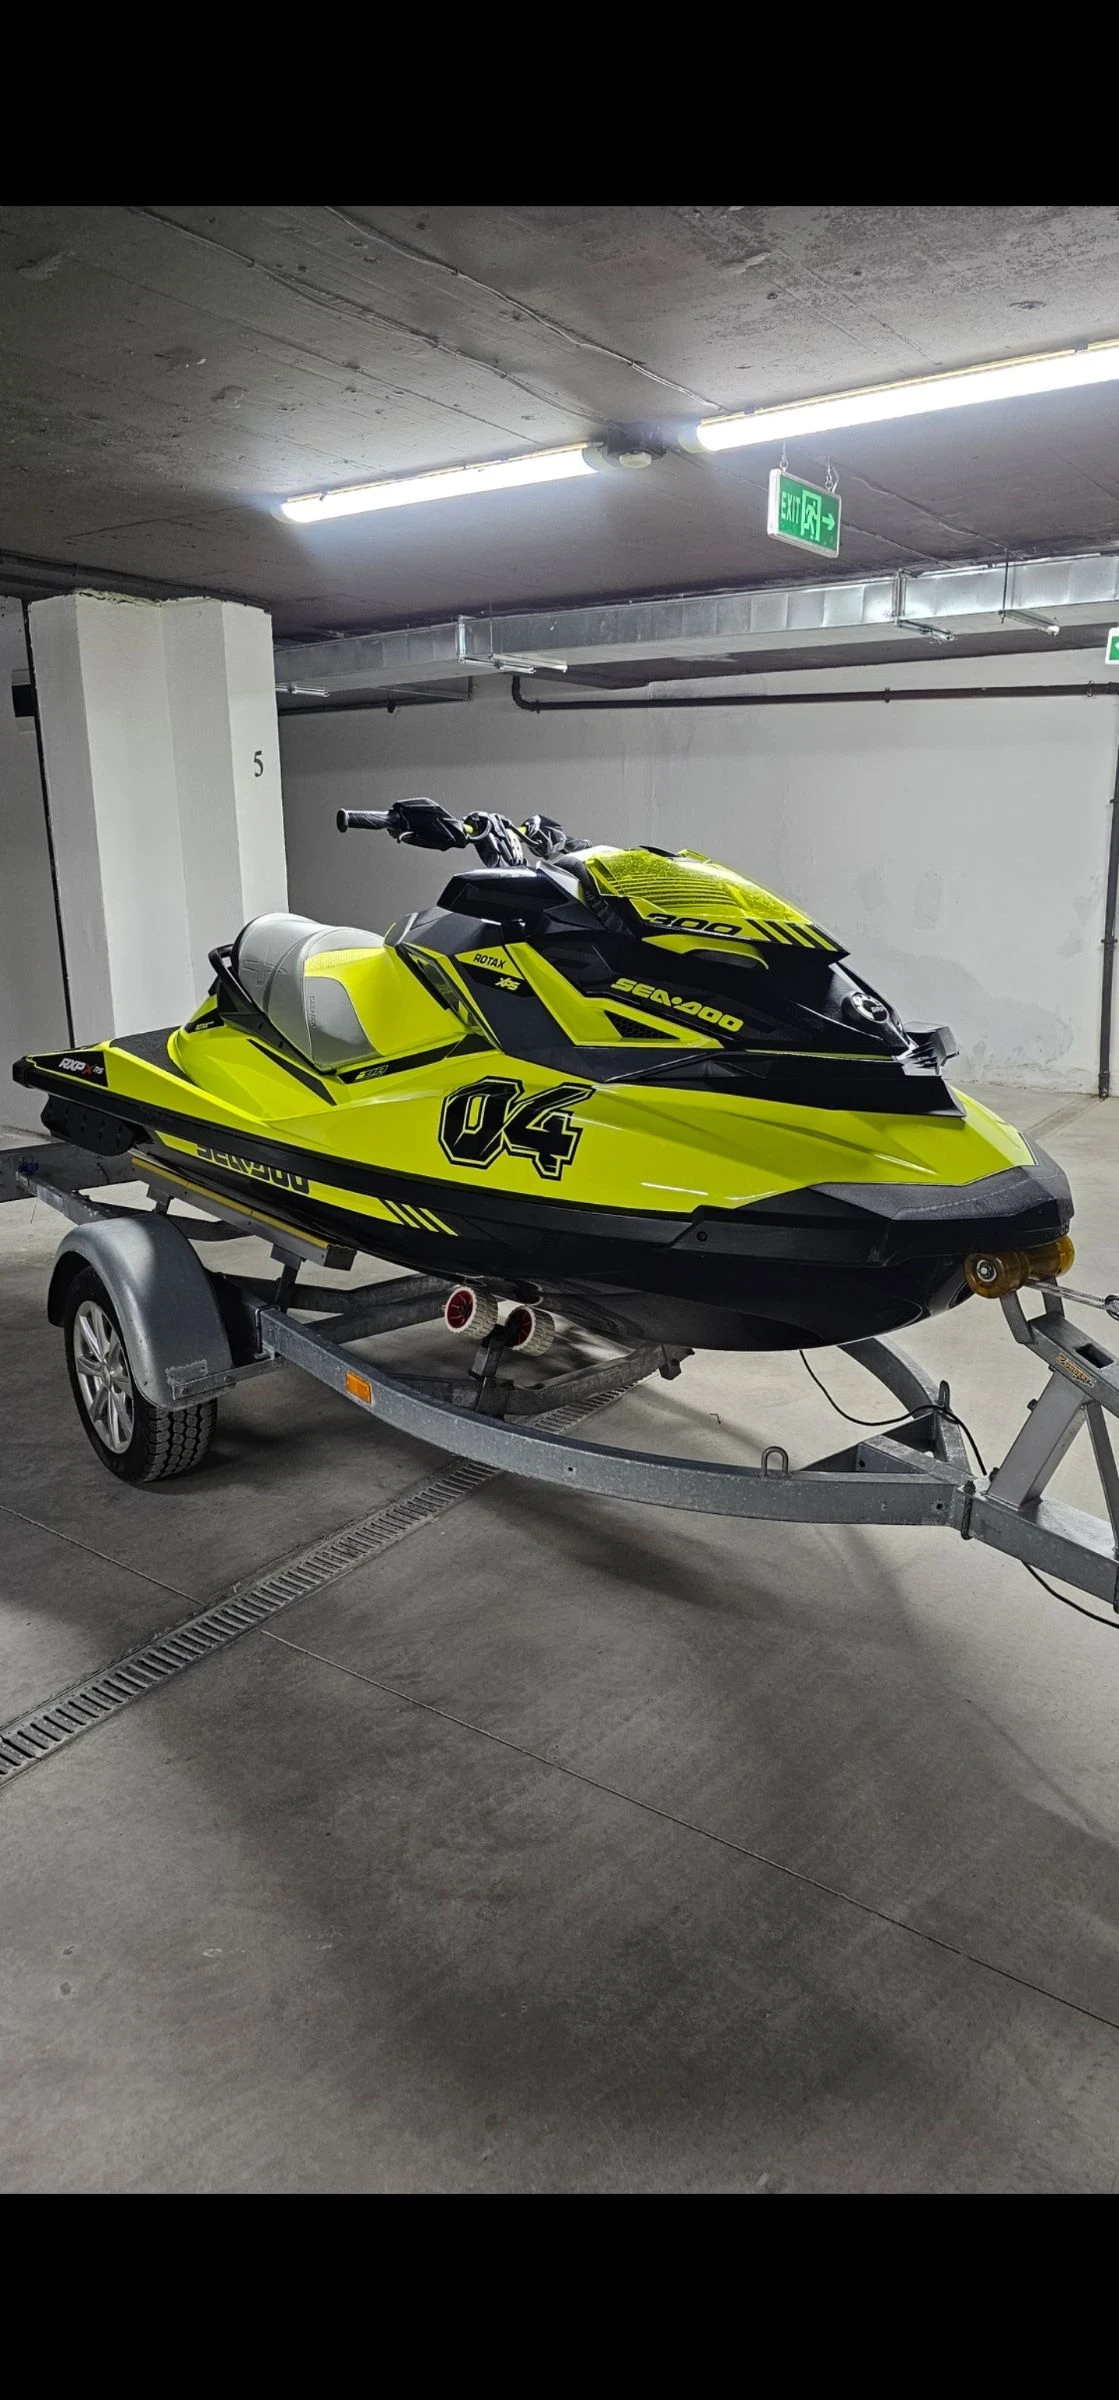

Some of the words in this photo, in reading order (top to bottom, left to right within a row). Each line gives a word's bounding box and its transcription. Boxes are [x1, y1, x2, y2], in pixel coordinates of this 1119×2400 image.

[781, 491, 801, 525] EXIT
[253, 750, 264, 778] 5
[646, 912, 742, 936] 300
[473, 953, 507, 969] ROTAX
[437, 1075, 597, 1182] 04
